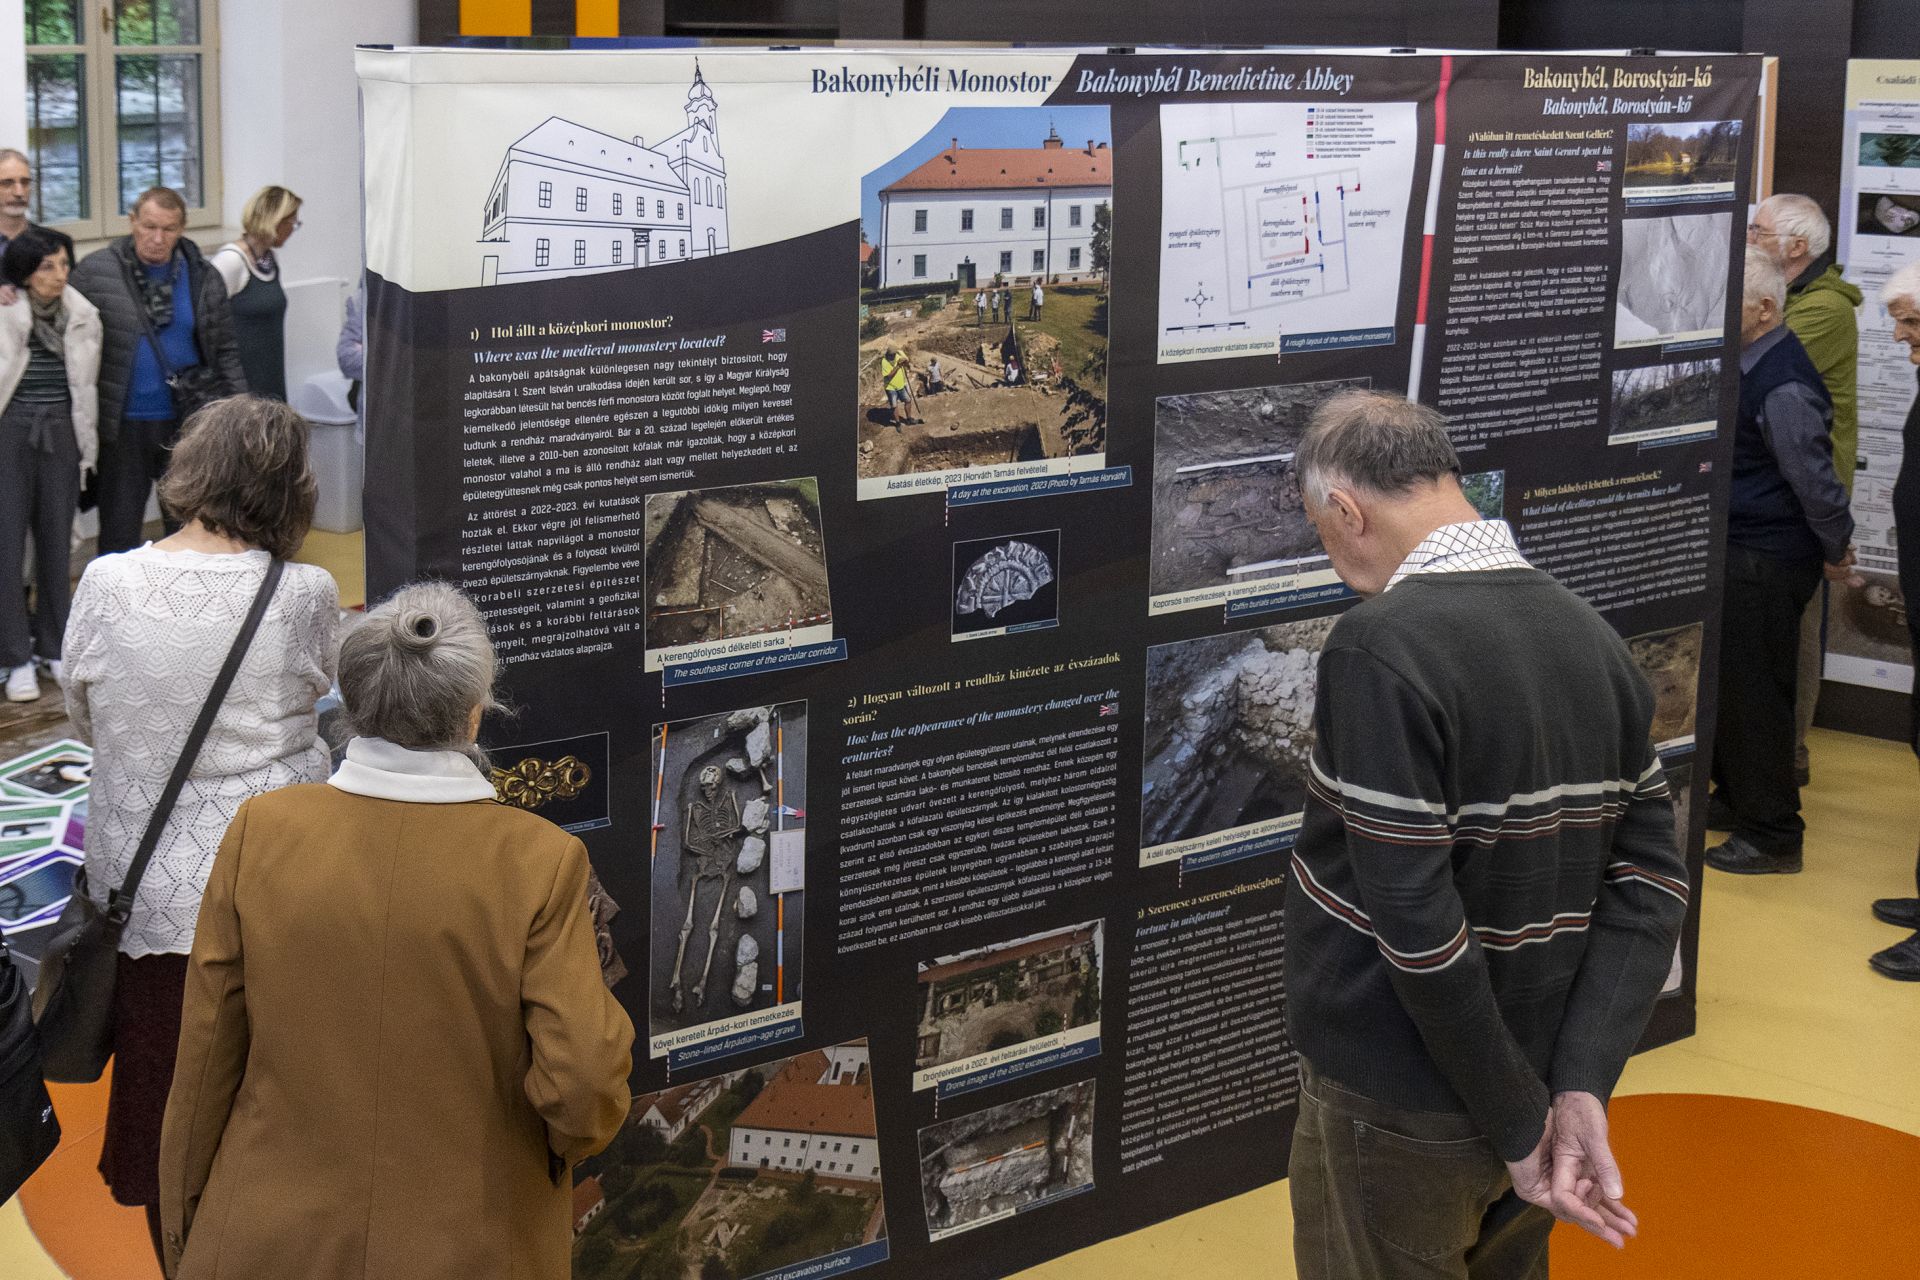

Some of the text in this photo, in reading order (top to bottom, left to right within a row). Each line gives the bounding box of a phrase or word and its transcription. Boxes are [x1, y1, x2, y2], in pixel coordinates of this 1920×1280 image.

[812, 65, 1054, 99] Bakonybéli Monostor
[1076, 66, 1354, 97] Bakonybél Benedictine Abbey
[1523, 65, 1712, 93] Bakonybél, Borostyán-kő
[1611, 95, 1694, 117] Borostyán-kő
[1475, 131, 1504, 141] Valóban
[1505, 131, 1514, 141] itt
[1514, 130, 1564, 140] remetéskedett
[1565, 130, 1585, 139] Szent
[1585, 129, 1614, 139] Gellért?
[1463, 145, 1613, 160] Is this really where Saint Gerard spent his
[1461, 166, 1478, 176] time
[1494, 164, 1523, 175] hermit?
[492, 325, 513, 338] Hol
[516, 324, 536, 337] állt
[539, 327, 546, 335] a
[549, 319, 607, 335] középkori
[611, 315, 673, 331] monostor?
[474, 335, 726, 364] Where was the medieval monastery located?
[469, 352, 788, 383] A bakonybéli apátságnak különlegesen nagy tekintélyt biztosított, hogy
[462, 485, 541, 502] épületegyüttesnek
[542, 483, 562, 494] még
[563, 480, 583, 491] csak
[584, 479, 613, 490] pontos
[614, 475, 638, 487] helyét
[639, 474, 658, 483] sem
[886, 480, 913, 490] Ásatási
[915, 476, 943, 487] életkép,
[944, 473, 962, 486] 2023
[963, 471, 992, 482] (Horváth
[993, 468, 1015, 478] Tamás
[951, 491, 957, 499] A
[958, 490, 972, 500] day
[971, 489, 980, 497] at
[980, 488, 992, 496] the
[1030, 480, 1048, 490] 2023
[1069, 478, 1078, 488] by
[1079, 475, 1100, 484] Tamás
[467, 495, 640, 521] Az áttörést a 2022-2023. évi kutatások
[657, 637, 785, 665] A kerengőfolyosó délkeleti sarka
[674, 646, 838, 678] The southeast corner of the circular corridor
[847, 652, 1120, 708] 2) Hogyan változott a rendház kinézete az évszázadok
[843, 710, 877, 725] során?
[846, 689, 1120, 746] How has the appearance of the monastery changed over the
[842, 745, 894, 765] centuries?
[1137, 908, 1145, 919] 3)
[1148, 899, 1190, 916] Szerencse
[1198, 873, 1285, 903] szerencsétlenségben?
[1135, 905, 1231, 938] Fortune in misfortune?
[653, 1009, 795, 1050] Kővel keretelt Árpád-kori temetkezés
[678, 1041, 724, 1061] Stone-lined
[774, 1025, 796, 1038] grave
[783, 1264, 823, 1280] excavation
[823, 1256, 851, 1270] surface
